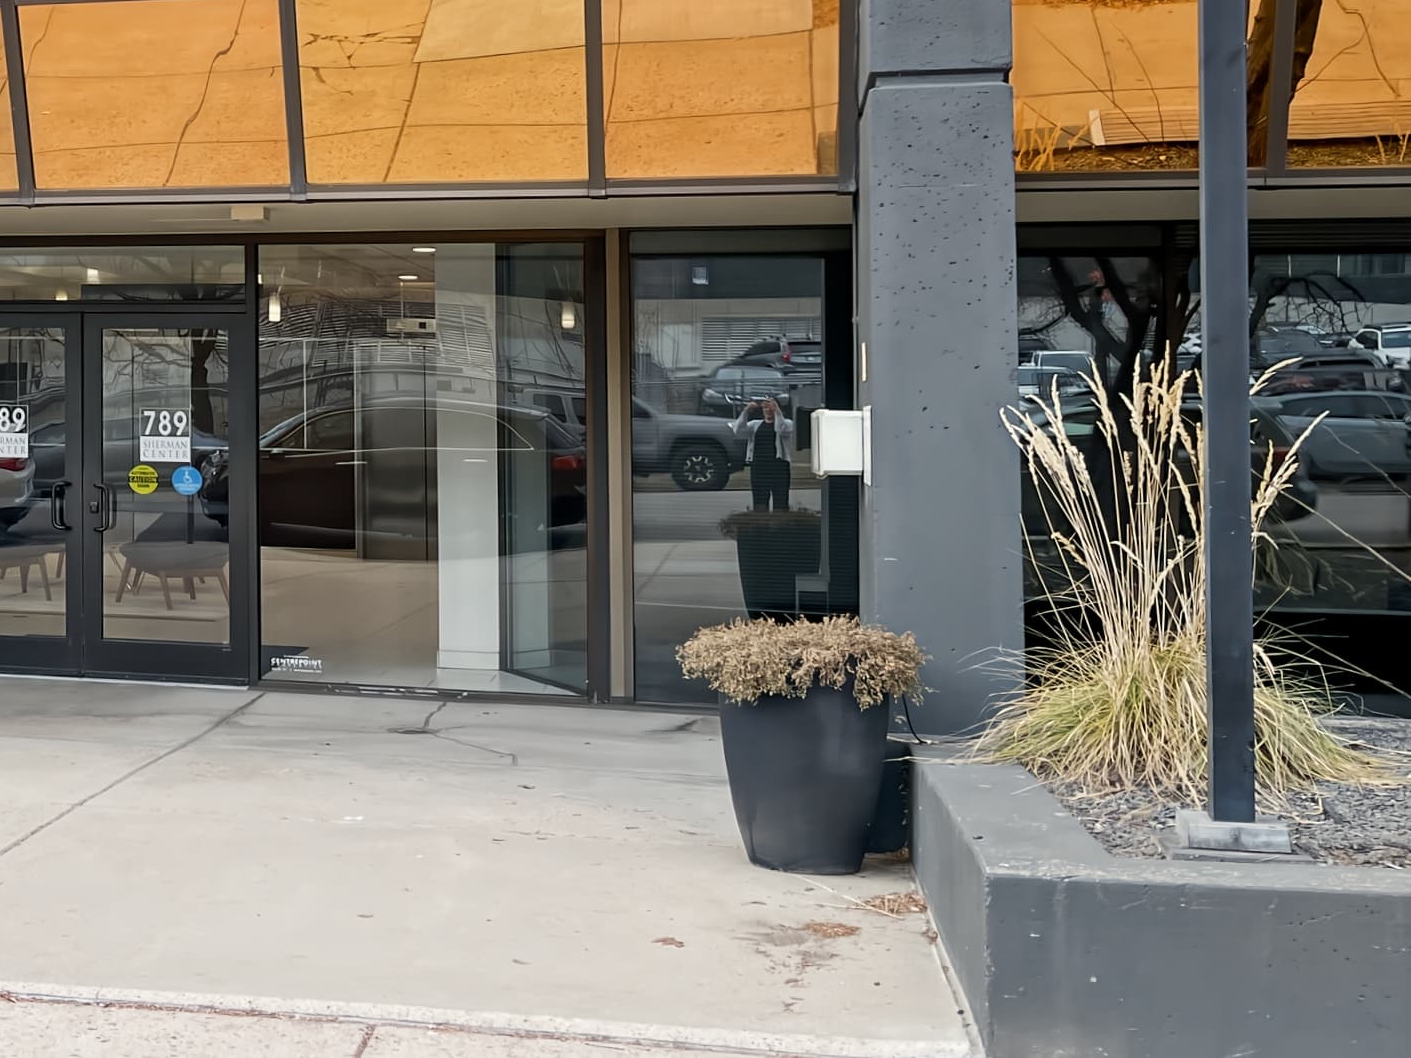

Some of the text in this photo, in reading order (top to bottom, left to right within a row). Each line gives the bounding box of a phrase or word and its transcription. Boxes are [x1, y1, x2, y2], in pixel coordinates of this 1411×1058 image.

[143, 410, 187, 435] 789
[143, 439, 188, 449] SHERMAN
[143, 449, 188, 459] CENTER
